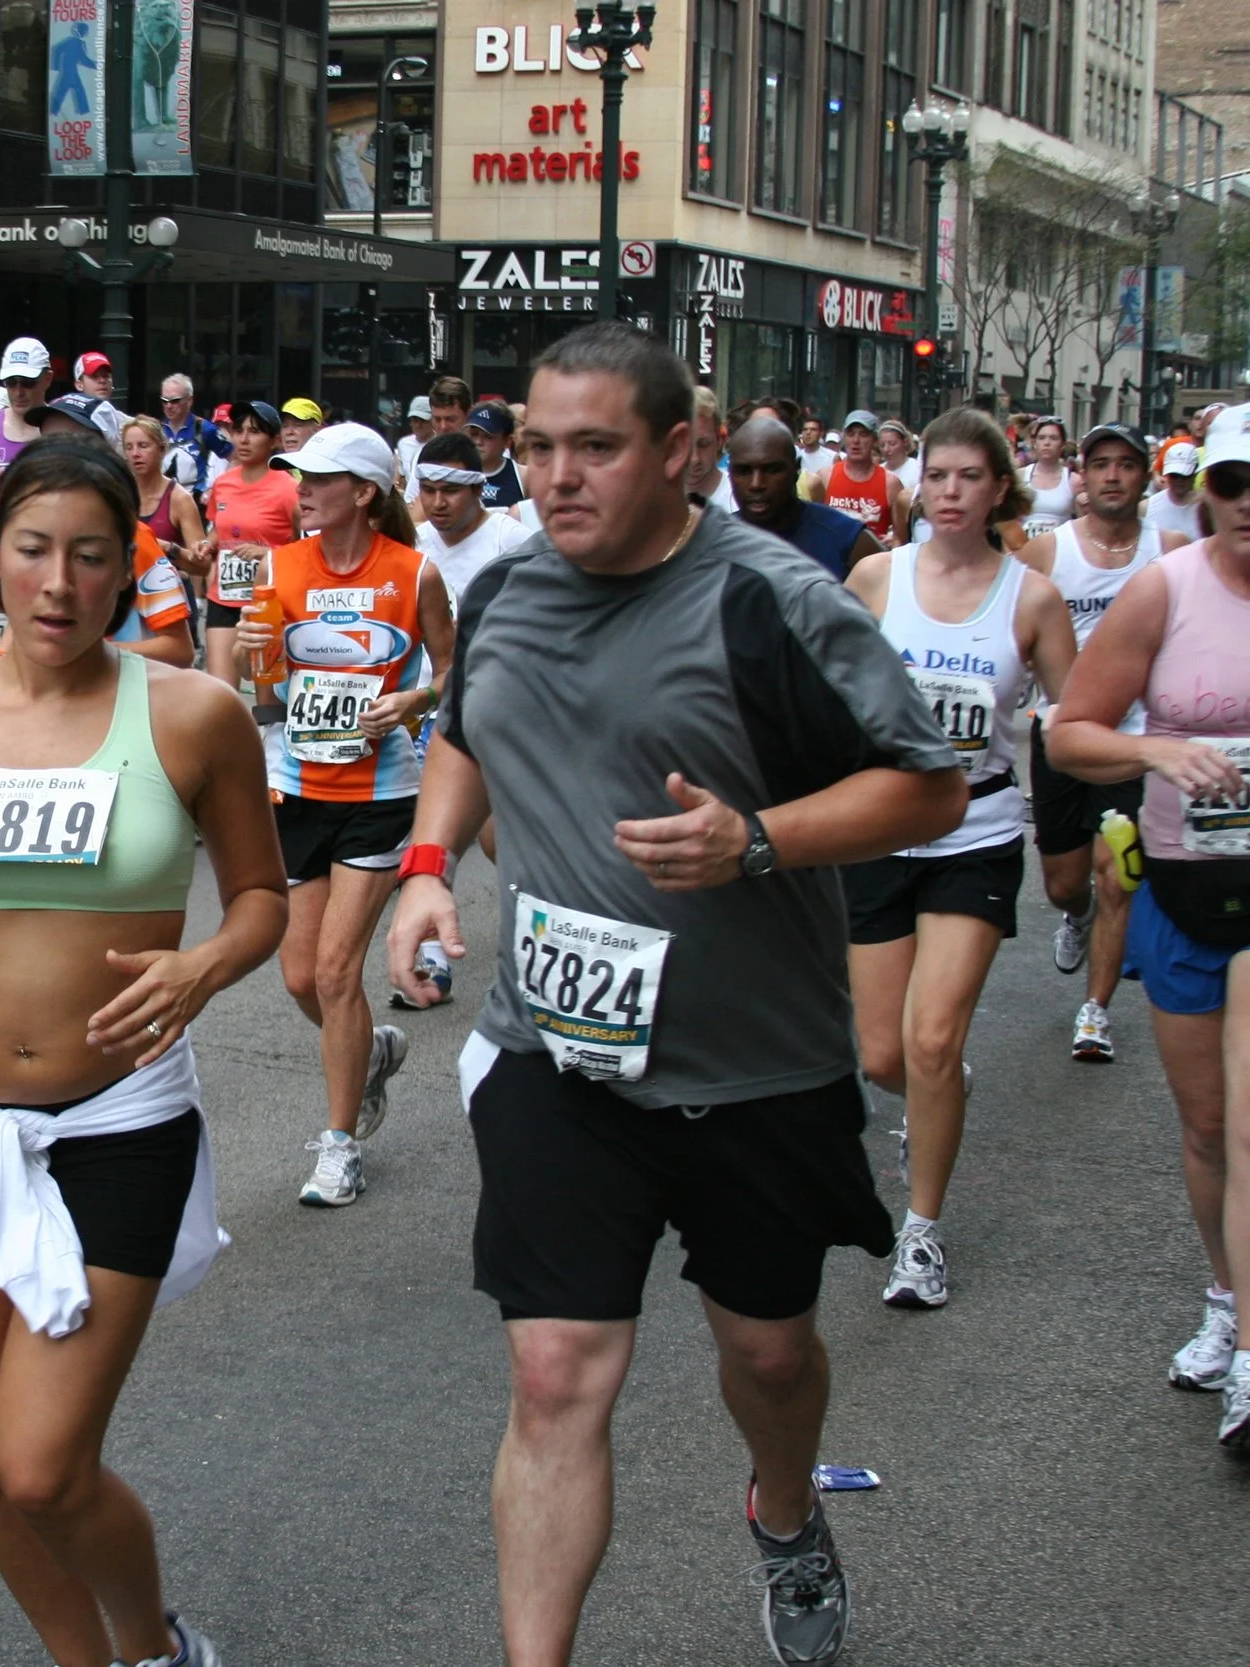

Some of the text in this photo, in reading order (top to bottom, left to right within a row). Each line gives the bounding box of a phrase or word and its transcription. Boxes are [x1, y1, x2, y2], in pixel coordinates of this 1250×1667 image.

[176, 40, 192, 155] LANDMARK
[54, 121, 92, 135] LOOP
[528, 97, 588, 134] art
[54, 147, 93, 161] LOOP
[255, 229, 394, 272] Amalgamated Bank of Chicago
[696, 253, 745, 300] ZALES
[843, 286, 883, 333] BLICK
[698, 294, 716, 375] ZALES
[829, 495, 859, 510] Jack's
[326, 613, 353, 622] team
[305, 646, 328, 654] World
[924, 648, 997, 677] Delta
[318, 678, 368, 690] LaSalle Bank
[955, 684, 980, 696] Bank
[48, 778, 87, 790] Bank
[550, 918, 639, 951] LaSalle Bank
[521, 935, 645, 1028] 27824
[549, 1017, 638, 1041] ANNIVERSARY
